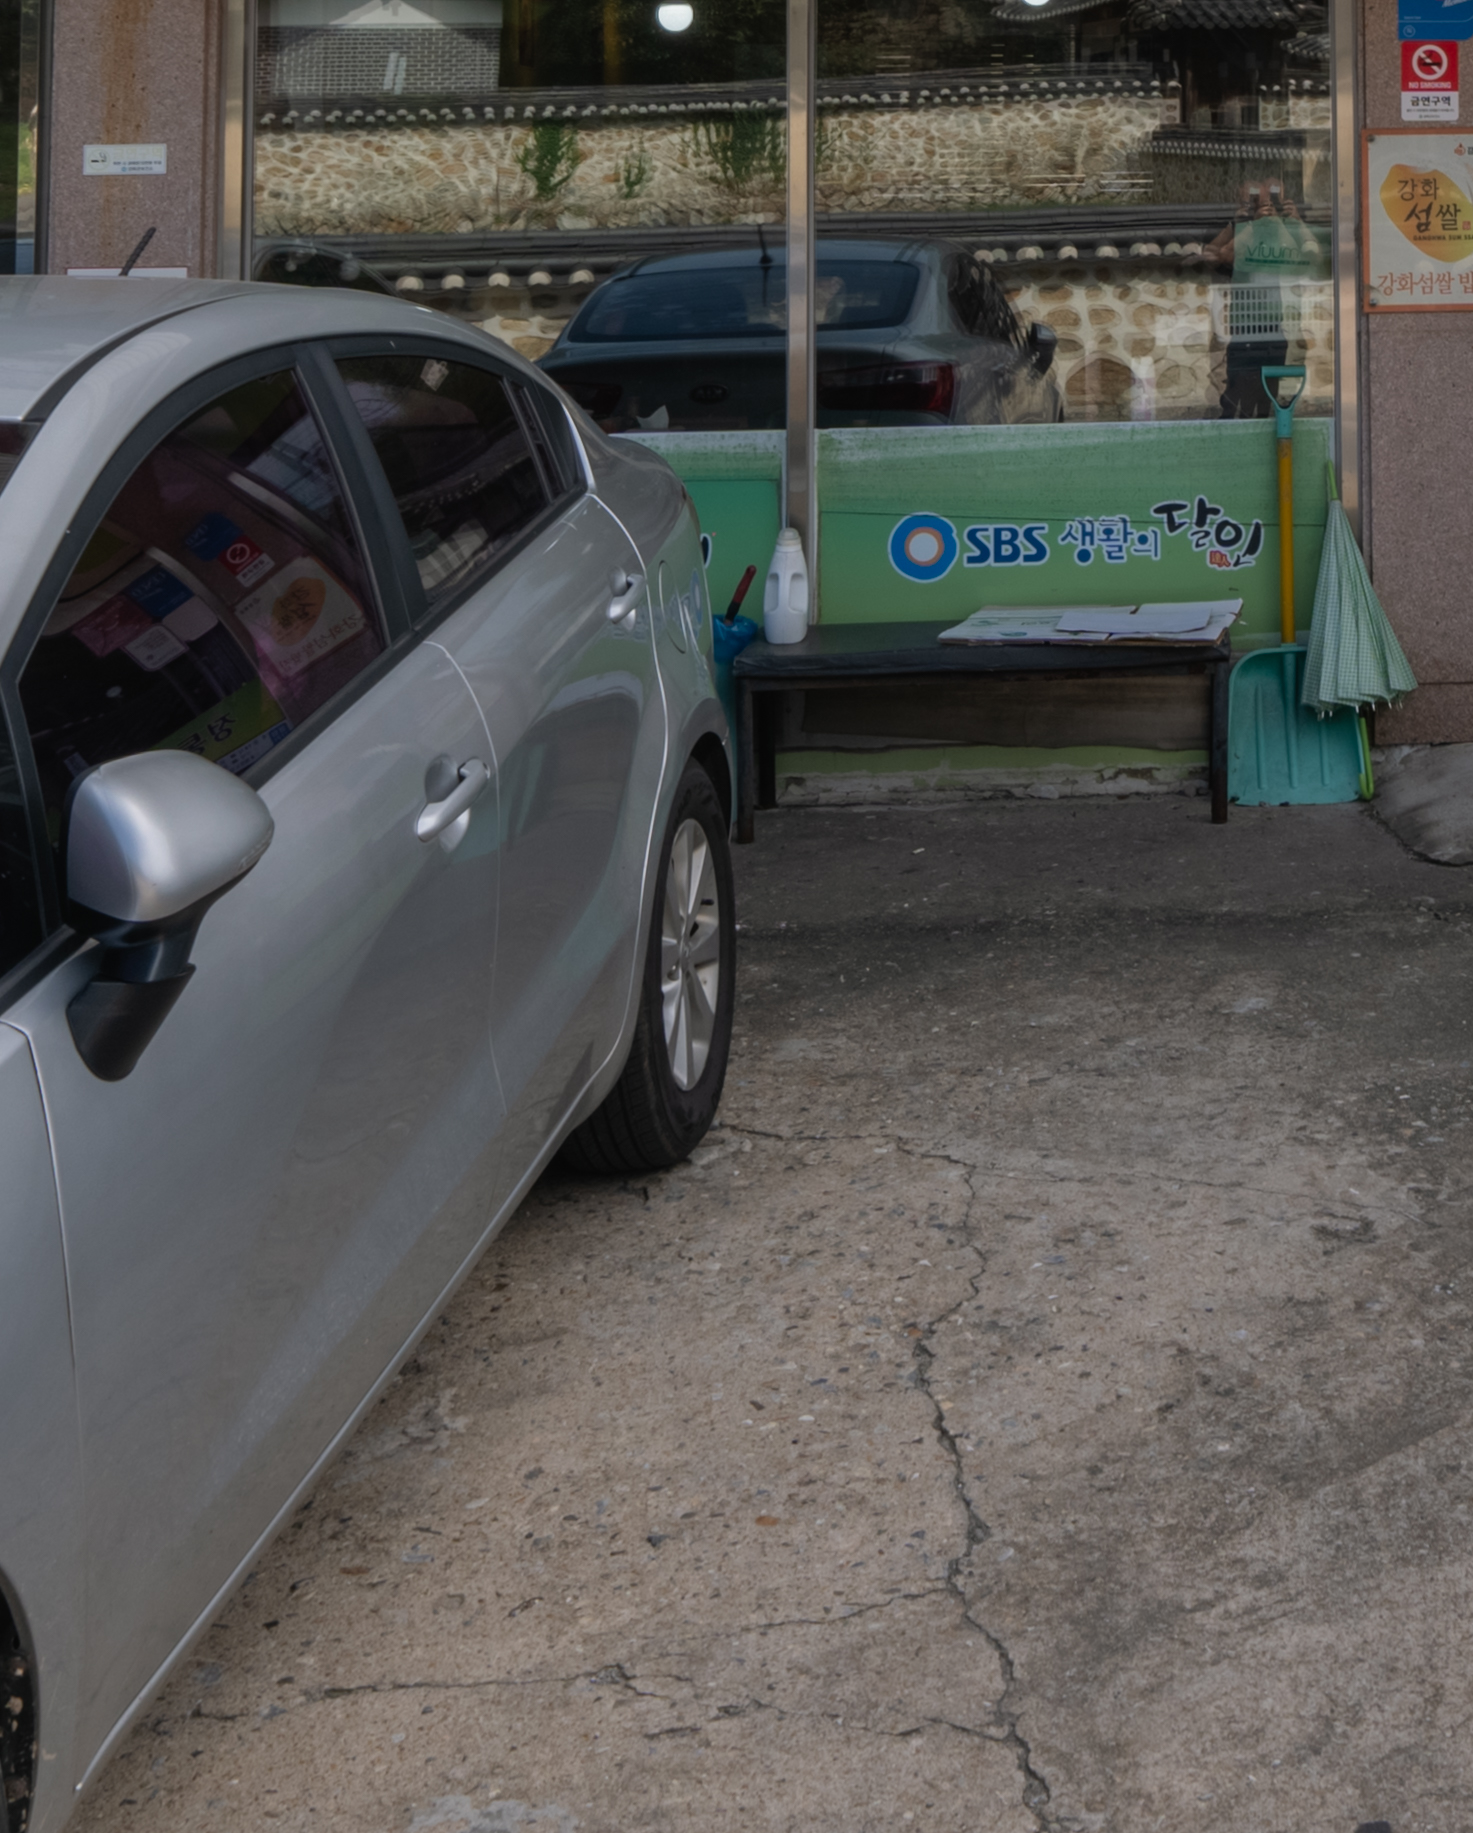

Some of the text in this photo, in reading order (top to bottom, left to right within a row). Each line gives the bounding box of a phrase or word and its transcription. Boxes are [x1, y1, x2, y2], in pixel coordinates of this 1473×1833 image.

[1409, 95, 1452, 107] 금연구역
[1397, 177, 1440, 202] 강화
[1403, 201, 1462, 234] 섬쌀
[1377, 270, 1455, 297] 강화섬쌀
[964, 525, 1049, 565] SBS
[1059, 517, 1160, 564] 생활의
